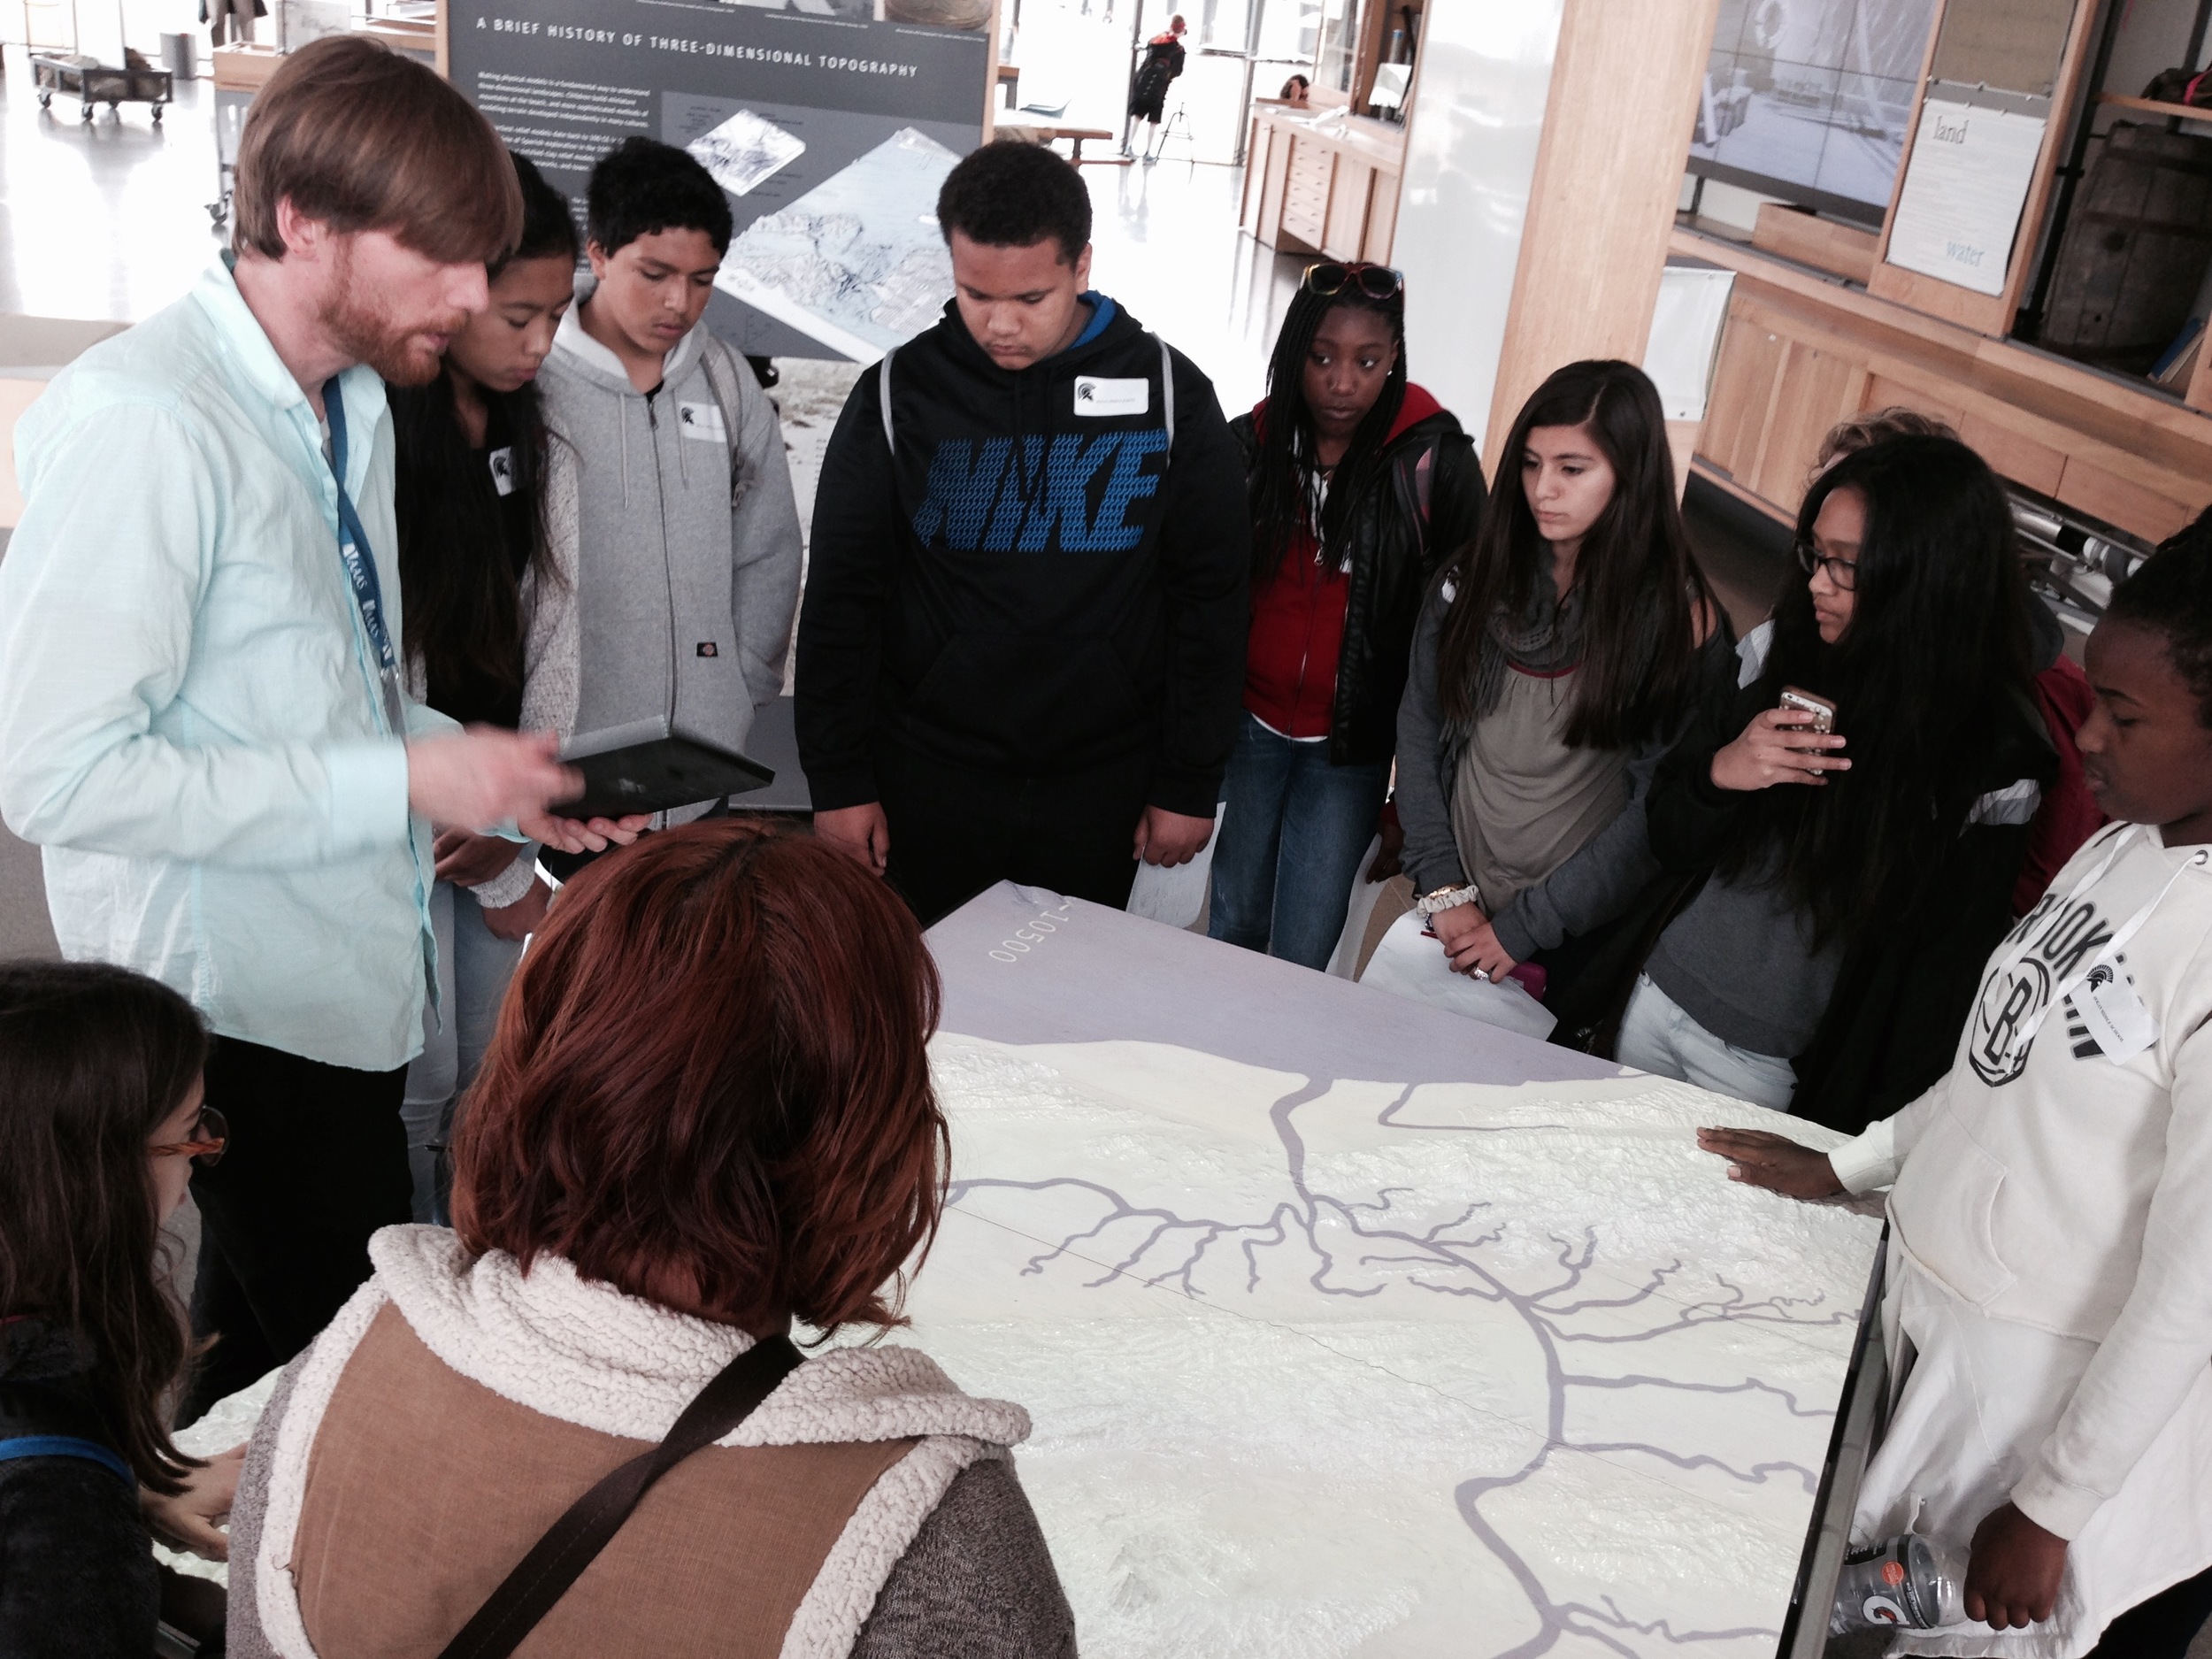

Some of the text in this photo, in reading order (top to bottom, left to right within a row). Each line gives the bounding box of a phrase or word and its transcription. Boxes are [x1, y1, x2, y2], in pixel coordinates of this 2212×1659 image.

[476, 17, 918, 78] A BRIEF HISTORY OF THREE-DIMENSIONAL TOPOGRAPHY
[1933, 116, 1970, 144] land
[1947, 242, 1985, 266] water
[912, 427, 1169, 553] NIKE
[1984, 977, 2032, 1065] B
